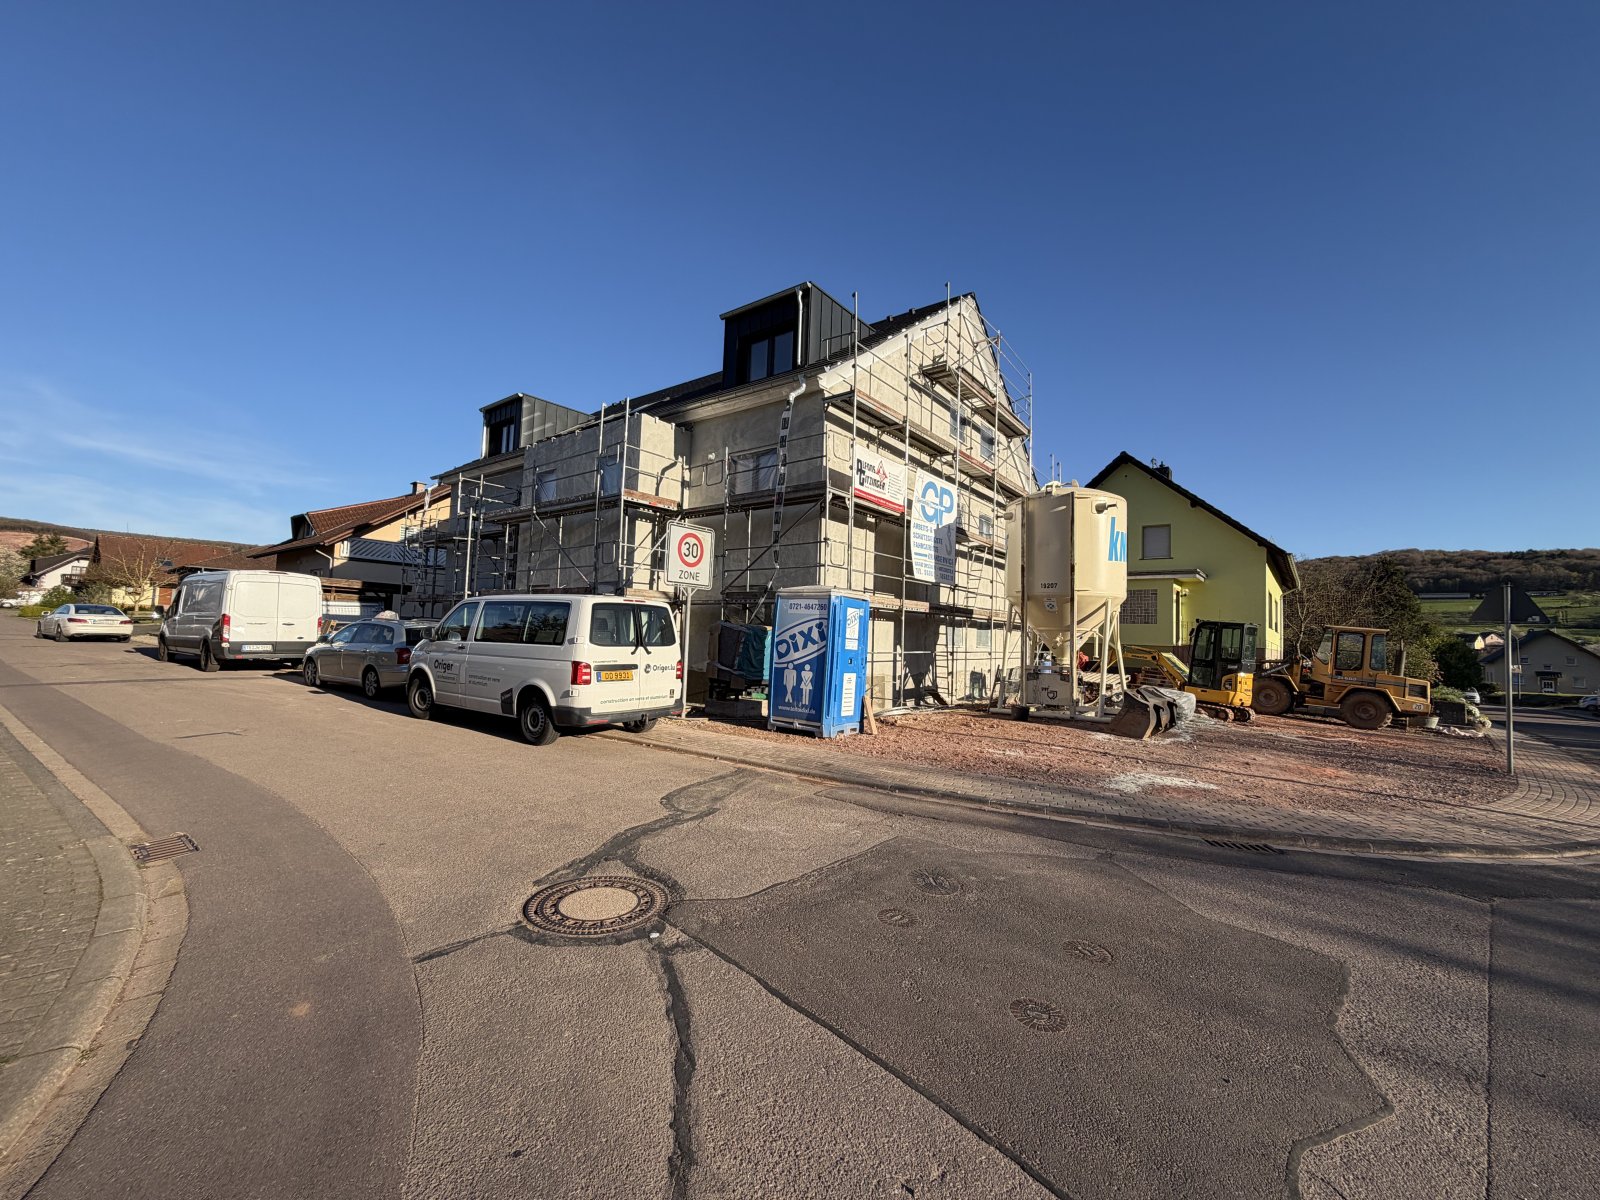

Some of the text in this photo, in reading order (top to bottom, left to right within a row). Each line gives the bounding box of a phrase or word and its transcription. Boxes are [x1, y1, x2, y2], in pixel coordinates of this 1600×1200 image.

[683, 542, 699, 559] 30
[678, 569, 700, 581] ZONE
[434, 659, 454, 673] Origer
[652, 663, 676, 673] Origer.lu
